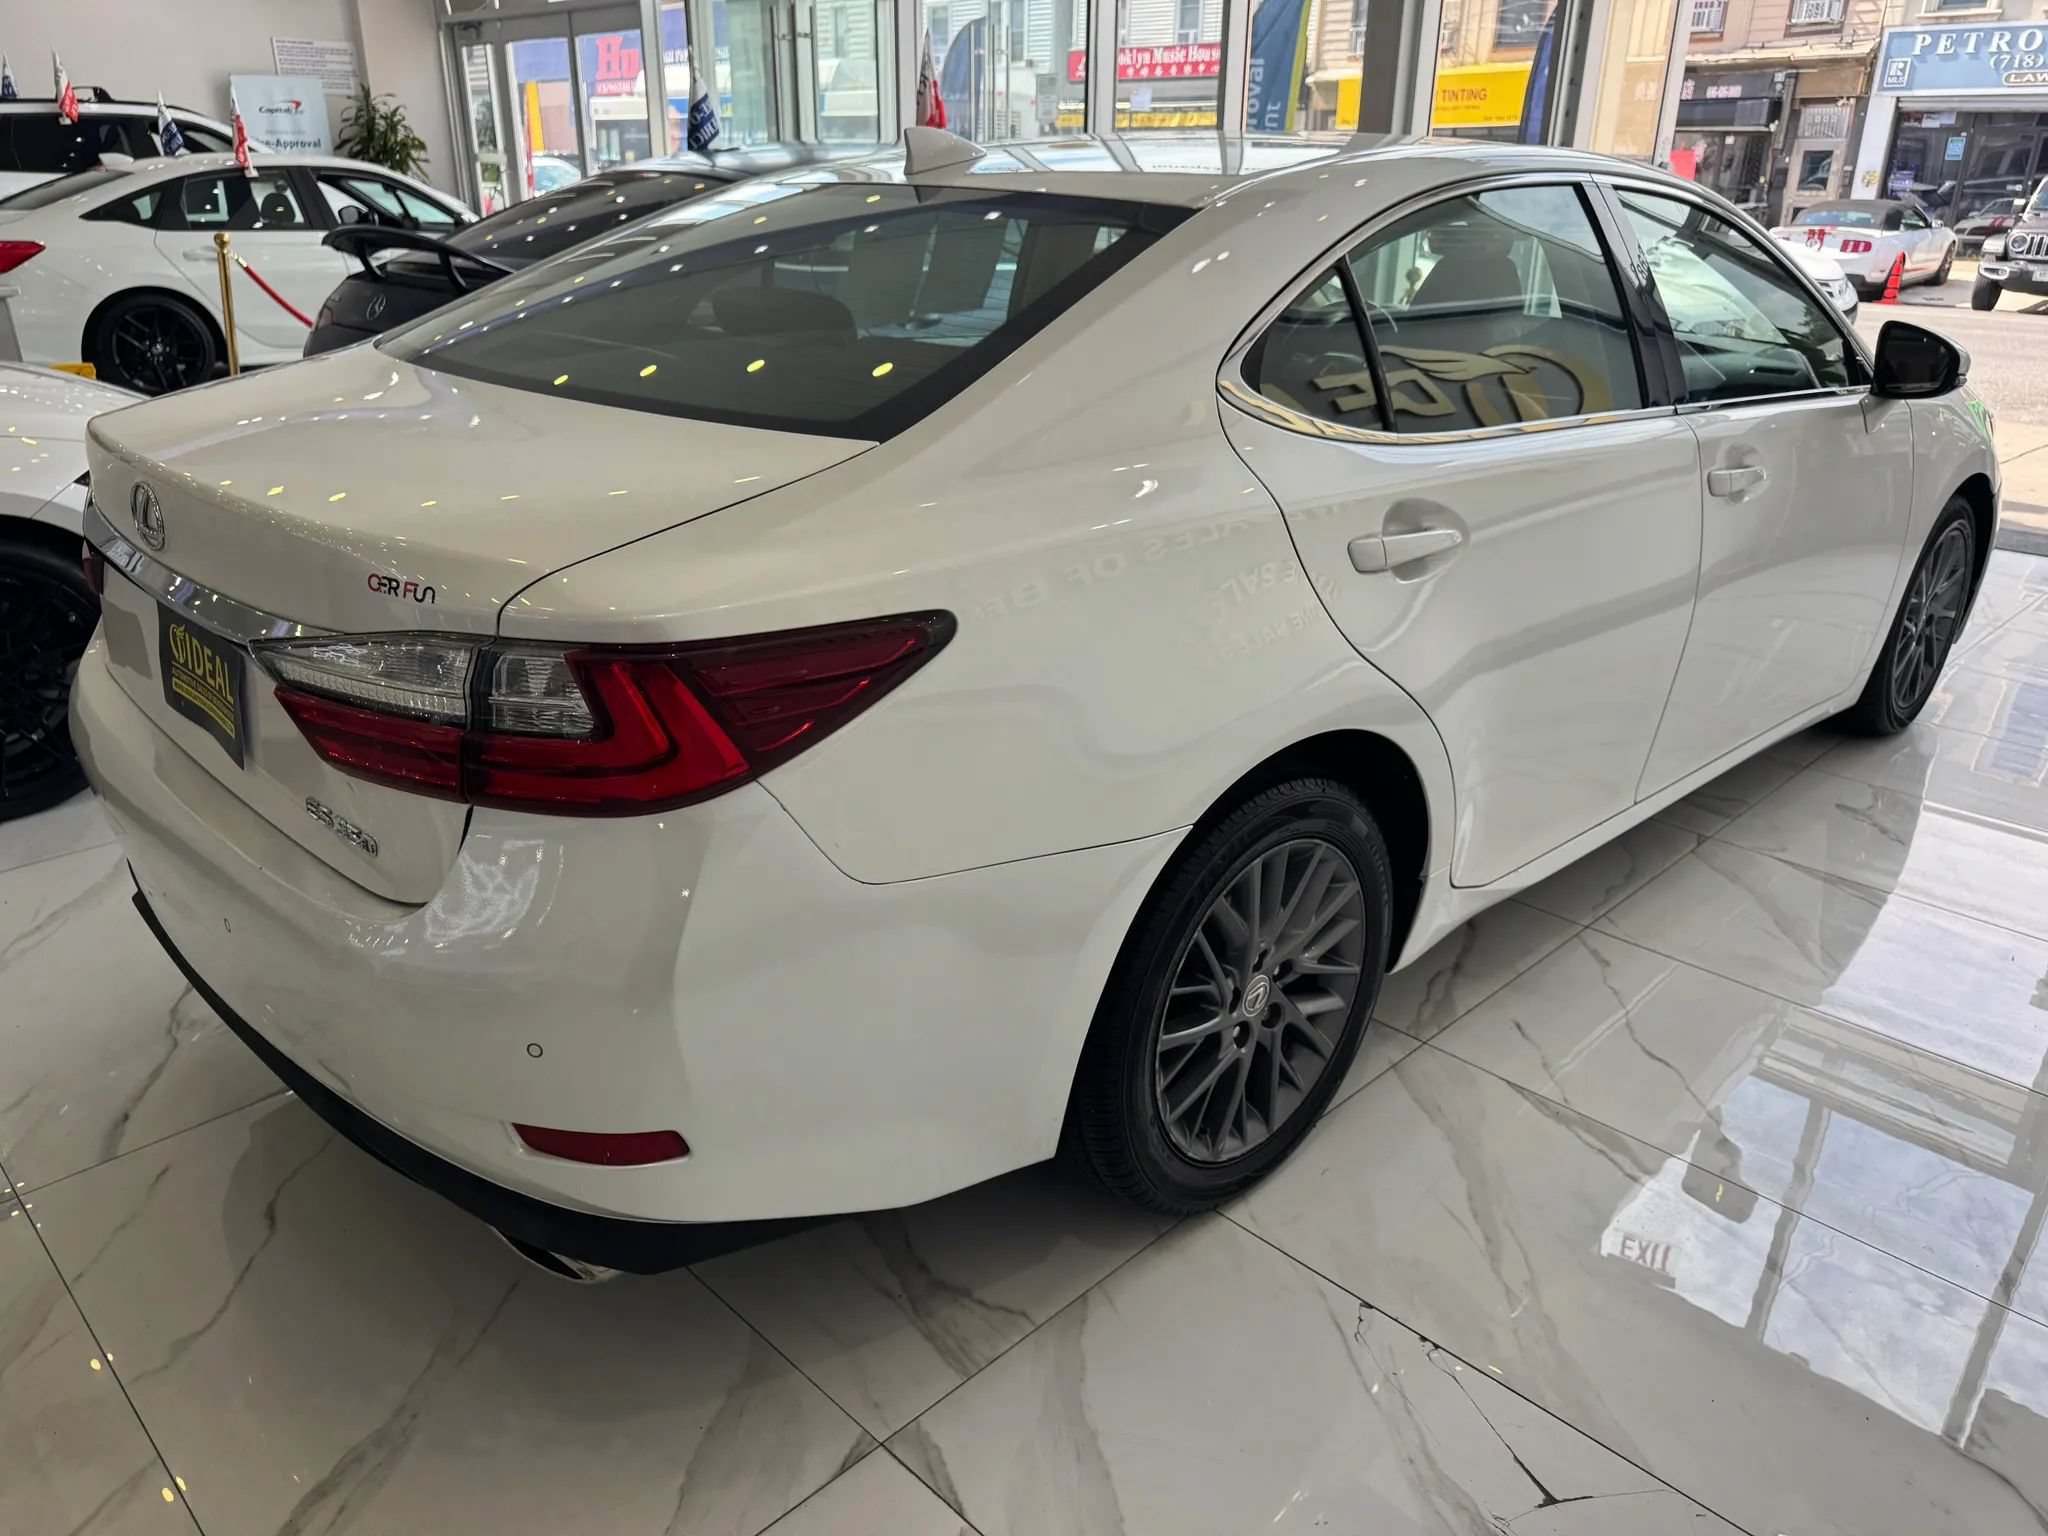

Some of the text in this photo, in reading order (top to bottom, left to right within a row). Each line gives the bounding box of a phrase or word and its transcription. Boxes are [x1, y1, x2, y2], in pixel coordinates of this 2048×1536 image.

[1911, 28, 2044, 57] PETRO
[1117, 47, 1151, 69] oklyn
[1152, 46, 1187, 65] Music
[1989, 53, 2045, 70] (718)
[1441, 87, 1488, 102] TINTING
[185, 631, 235, 705] IDEAL
